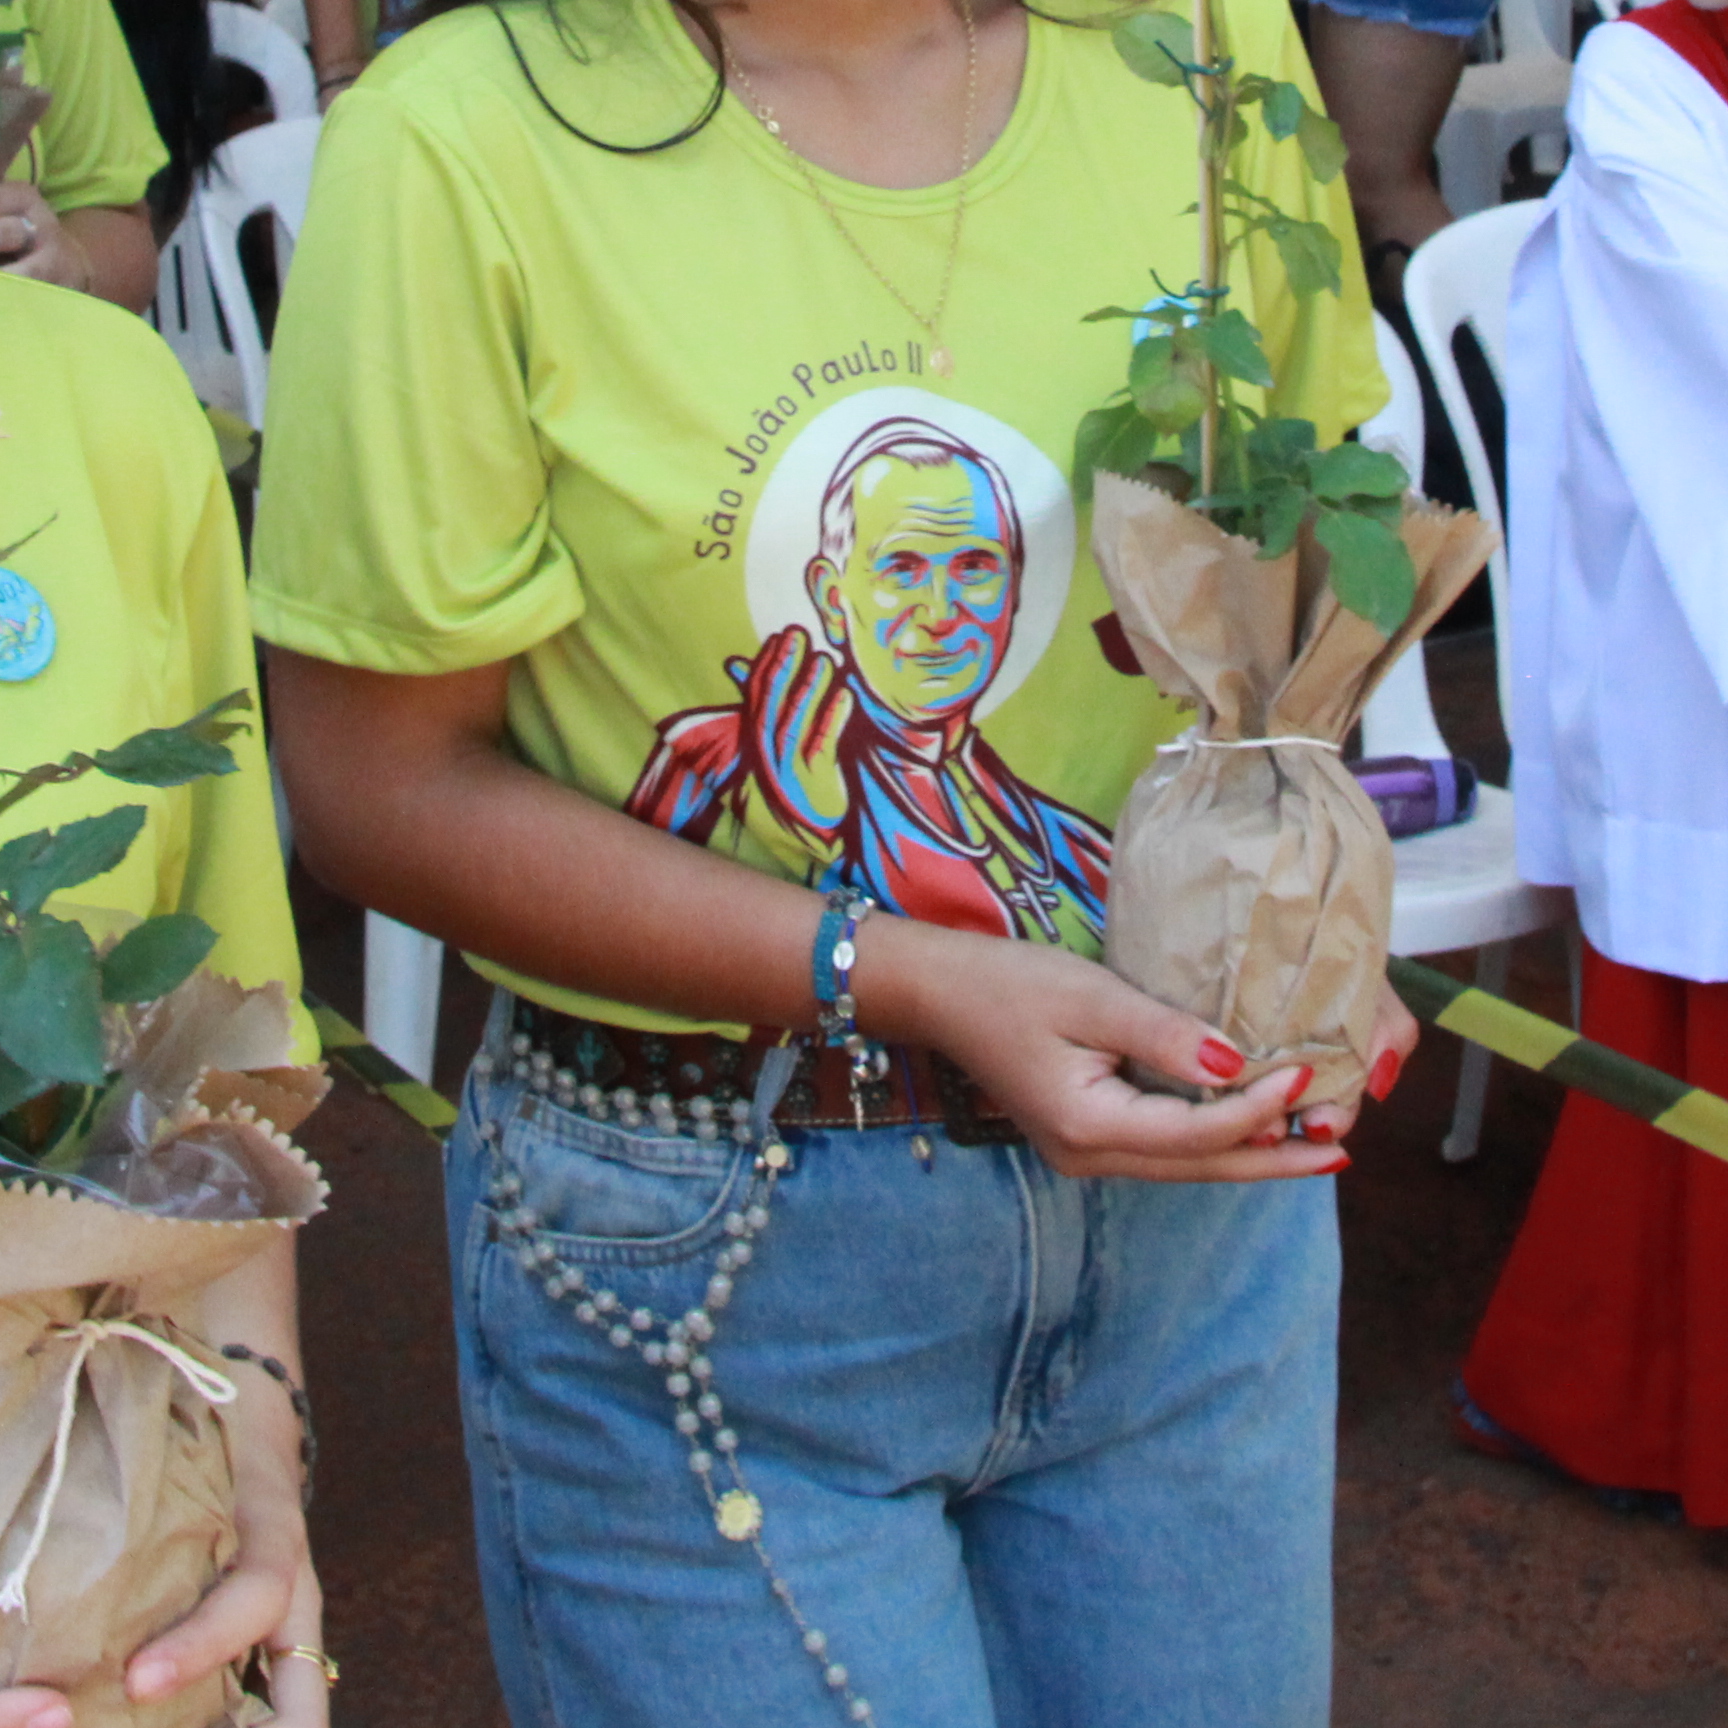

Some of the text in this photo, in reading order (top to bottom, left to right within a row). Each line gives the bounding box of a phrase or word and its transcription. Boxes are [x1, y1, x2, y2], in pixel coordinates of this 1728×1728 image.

[694, 488, 743, 562] São
[725, 394, 799, 476] João
[907, 341, 924, 376] II
